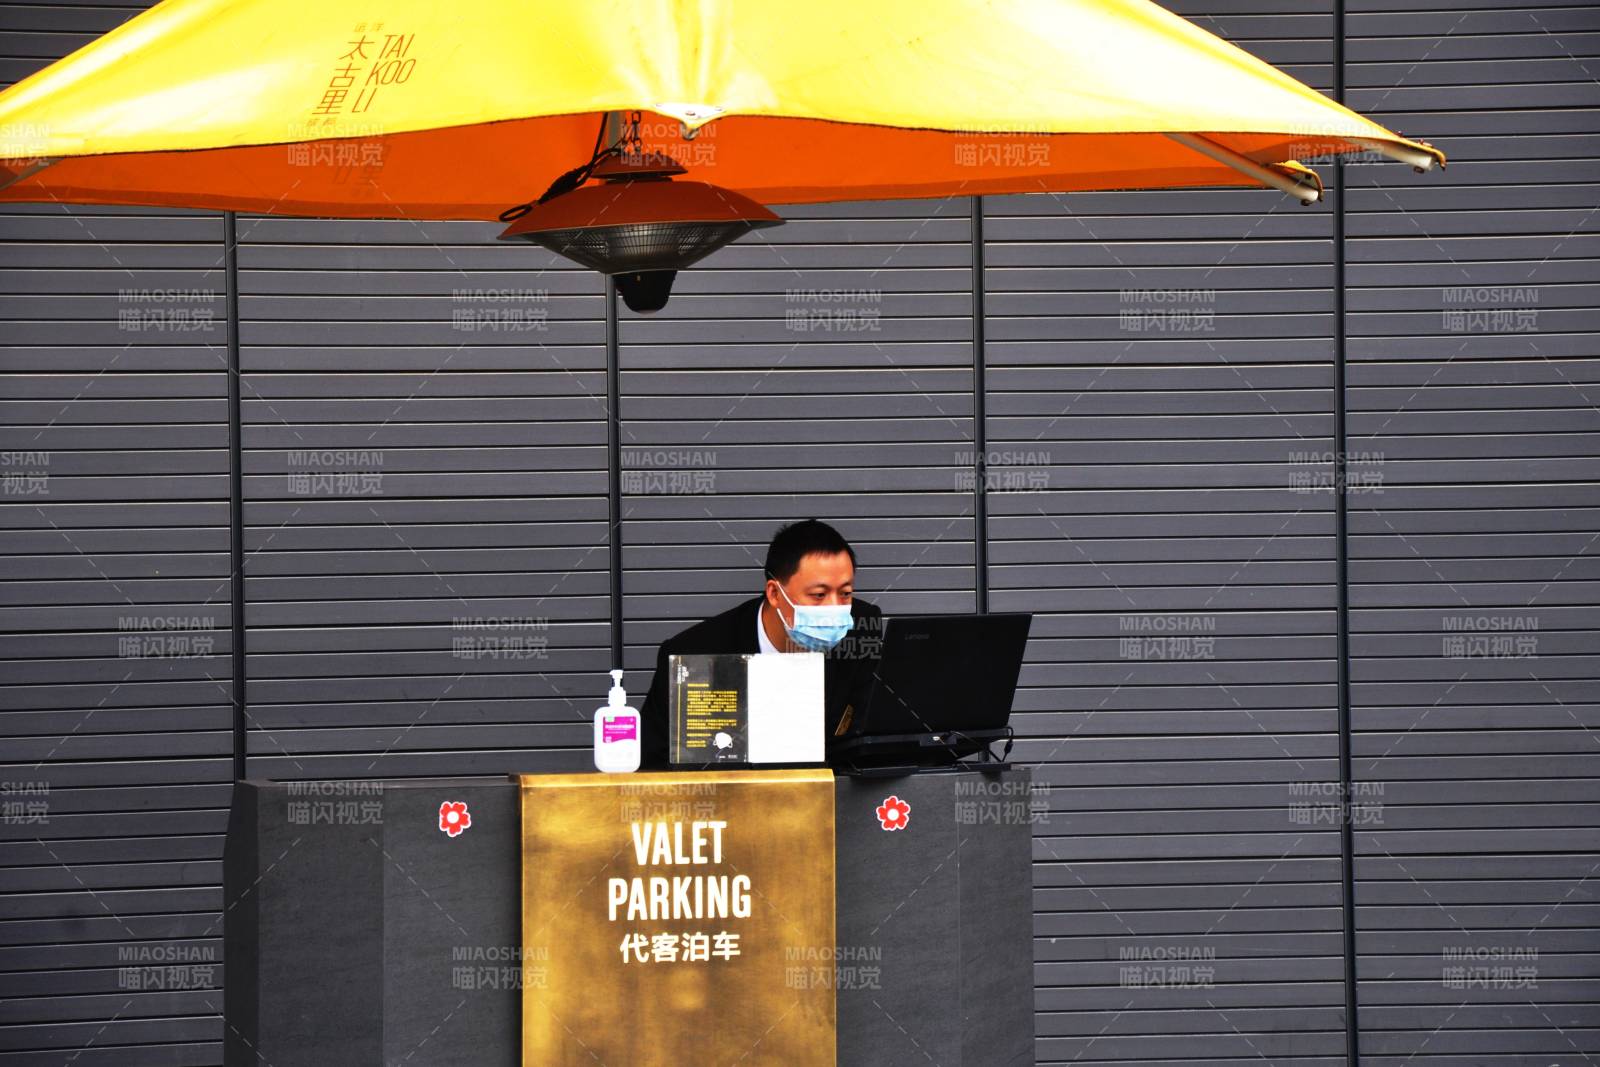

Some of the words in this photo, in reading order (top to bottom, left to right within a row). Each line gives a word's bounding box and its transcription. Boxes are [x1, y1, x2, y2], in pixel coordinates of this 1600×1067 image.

[379, 33, 415, 59] TAI
[311, 35, 376, 114] 太古里
[365, 58, 417, 86] KOO
[351, 87, 377, 113] LI
[631, 821, 727, 865] VALET
[608, 874, 751, 921] PARKING
[620, 931, 741, 964] 代客泊车
